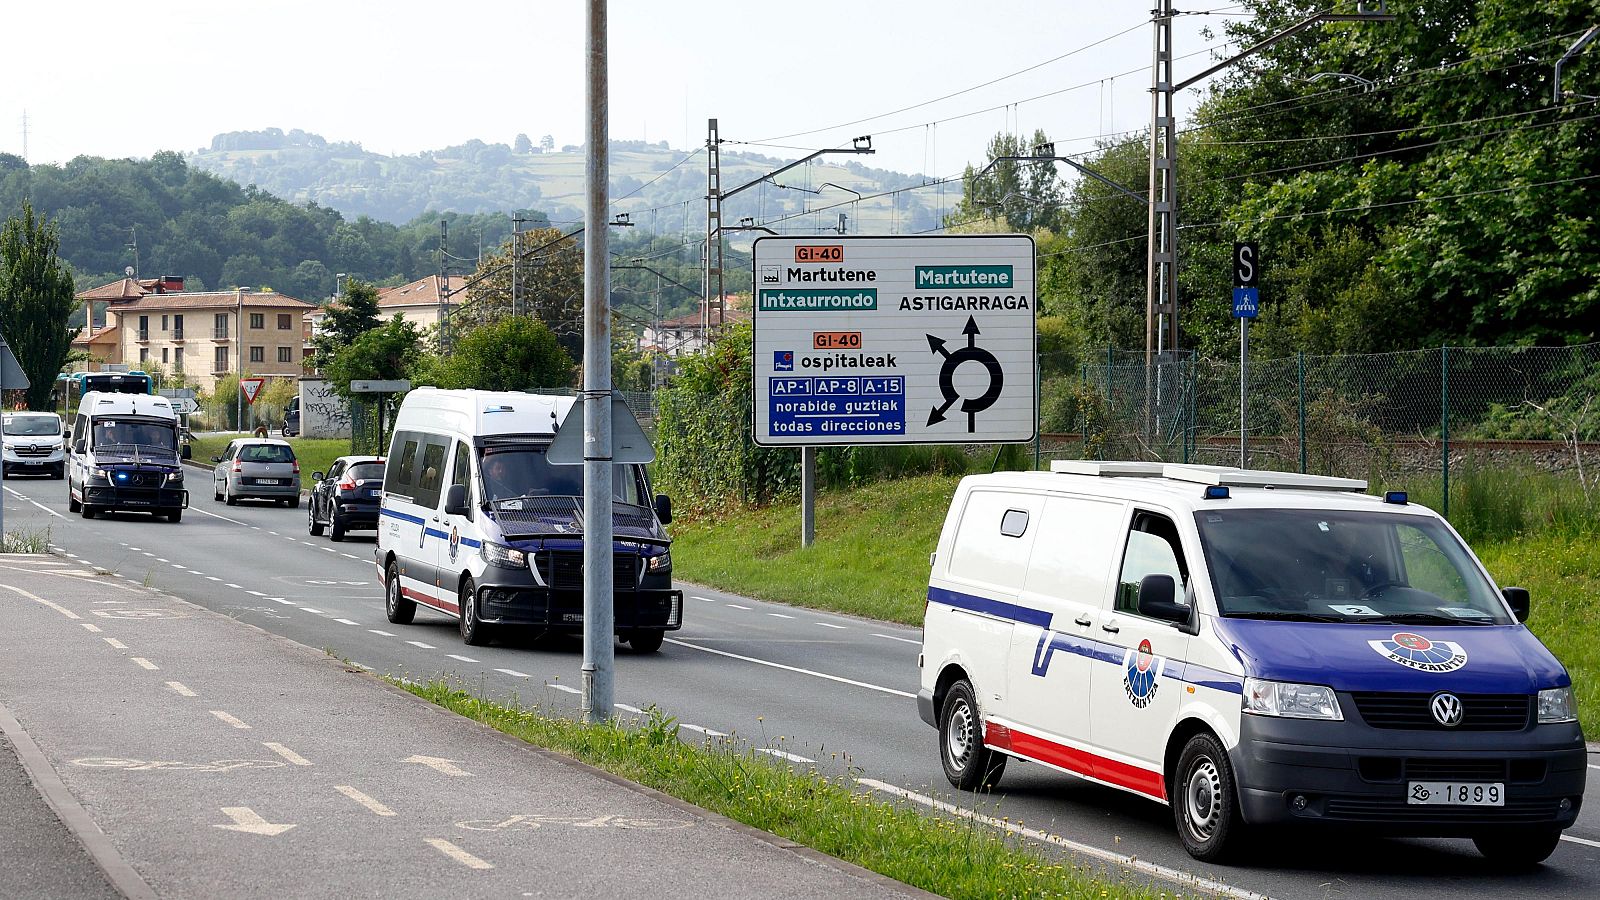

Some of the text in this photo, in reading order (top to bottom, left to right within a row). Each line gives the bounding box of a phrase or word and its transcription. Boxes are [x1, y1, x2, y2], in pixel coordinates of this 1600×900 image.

[797, 248, 840, 260] GI-40
[1239, 246, 1252, 281] S
[787, 268, 876, 282] Martutene
[919, 270, 1009, 285] Martutene
[762, 293, 873, 307] Intxaurrondo
[899, 296, 1029, 310] ASTIGARRAGA
[815, 334, 860, 347] GI-40
[801, 353, 897, 371] ospitaleak
[775, 381, 810, 393] AP-1
[818, 380, 856, 393] AP-8
[864, 379, 899, 392] A-15
[776, 400, 898, 413] norabide guztiak
[774, 420, 901, 432] todas direcciones
[1388, 653, 1466, 672] ERTZAINTZA
[1123, 676, 1158, 709] ERTZAINTZA
[1446, 785, 1499, 803] 1899
